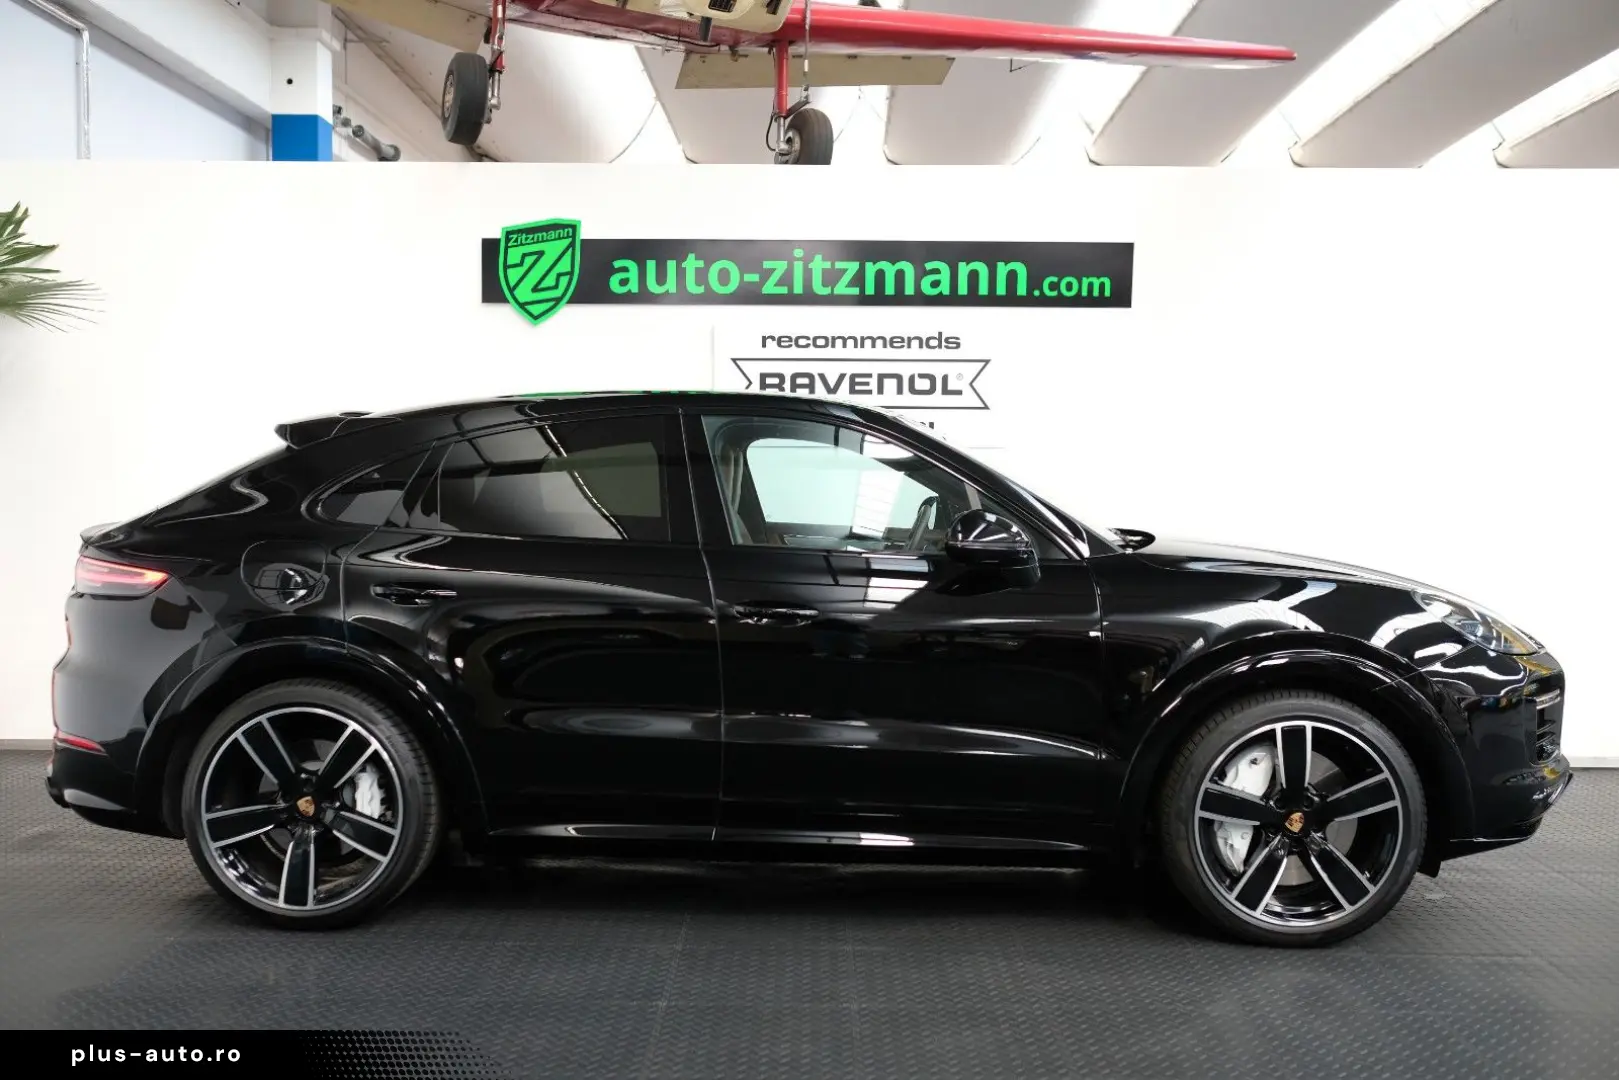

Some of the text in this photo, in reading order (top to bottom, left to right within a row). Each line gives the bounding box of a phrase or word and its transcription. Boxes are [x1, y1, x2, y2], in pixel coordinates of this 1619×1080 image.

[507, 227, 573, 246] Zitzmann
[608, 248, 1111, 297] auto-zitzmann.com
[761, 331, 961, 350] recommends
